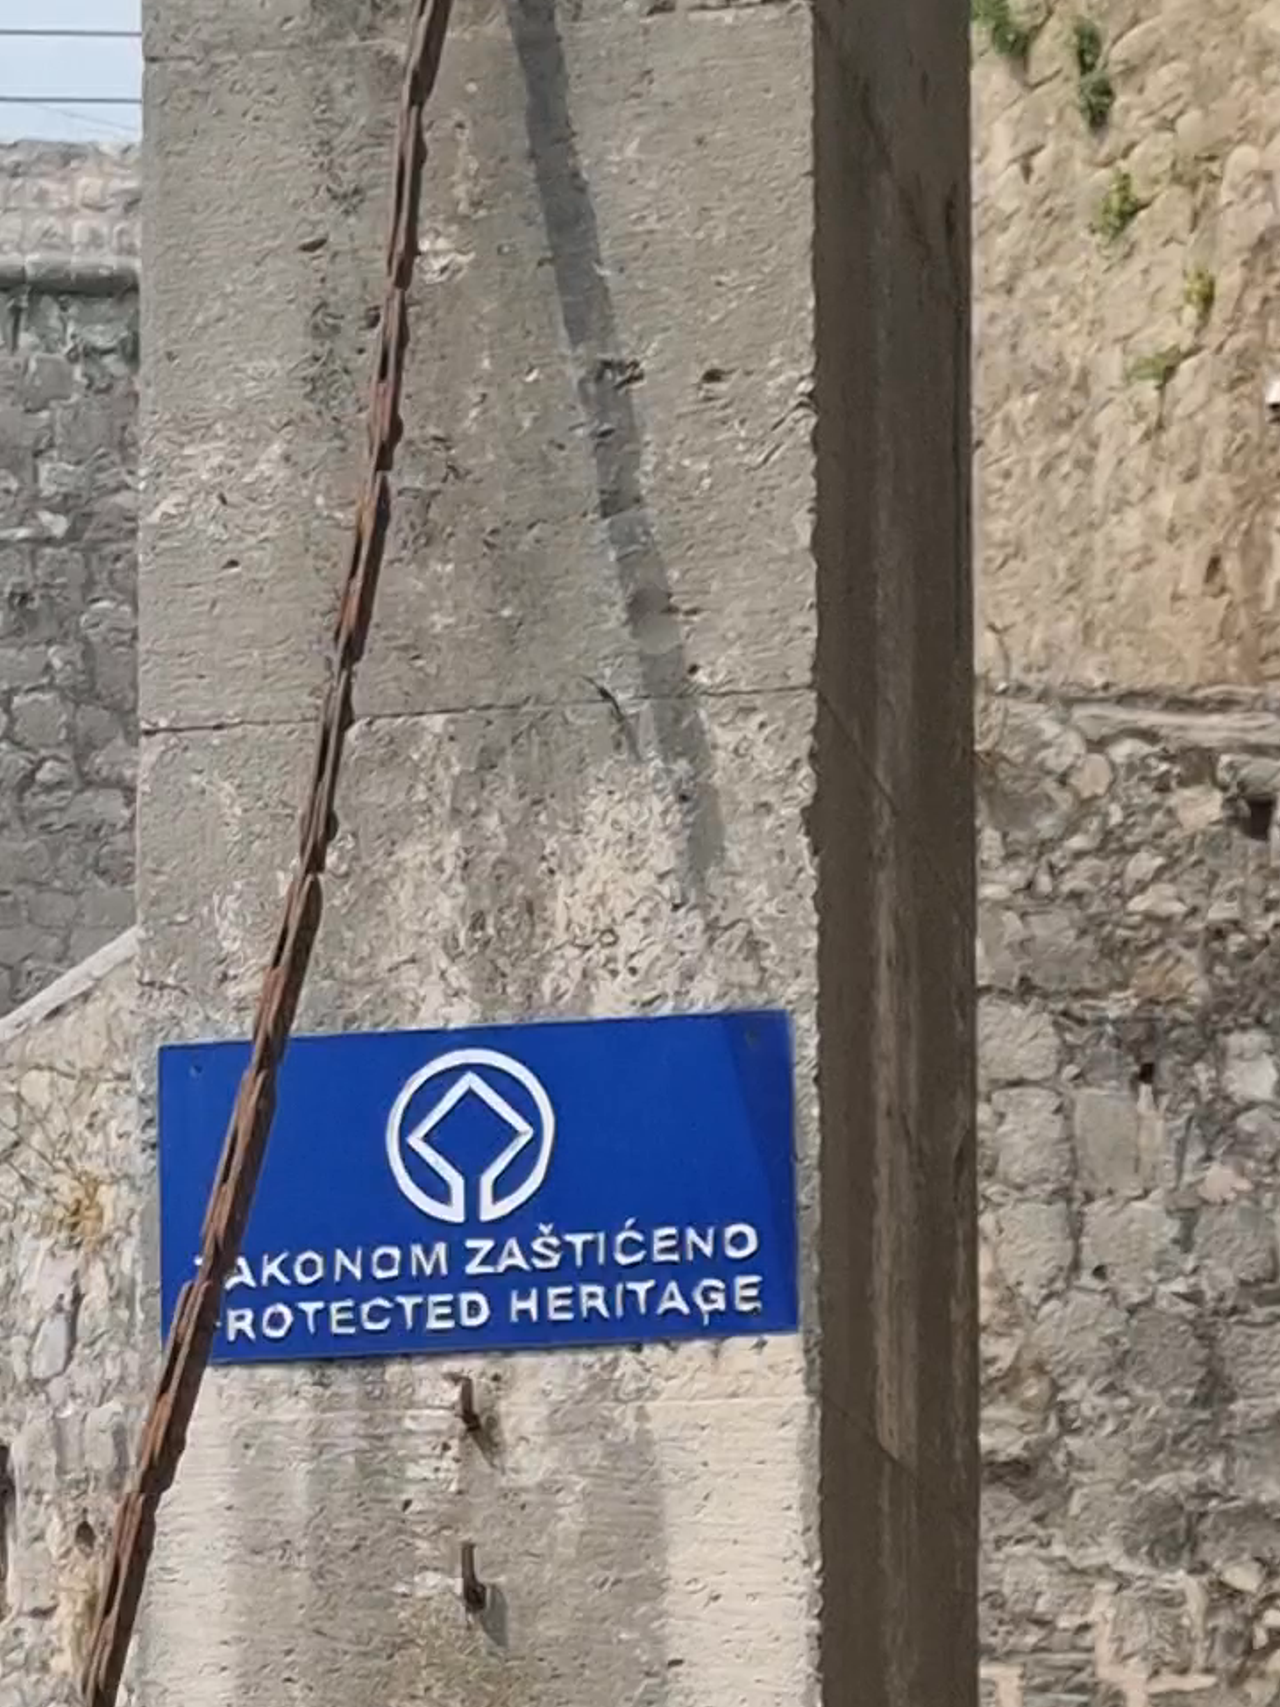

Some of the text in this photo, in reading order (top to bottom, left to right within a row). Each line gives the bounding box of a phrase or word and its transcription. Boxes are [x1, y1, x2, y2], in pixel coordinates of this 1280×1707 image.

[193, 1217, 759, 1291] AKONOM ZAŠTIĆENO
[214, 1274, 763, 1343] ROTECTED HERITAGE
